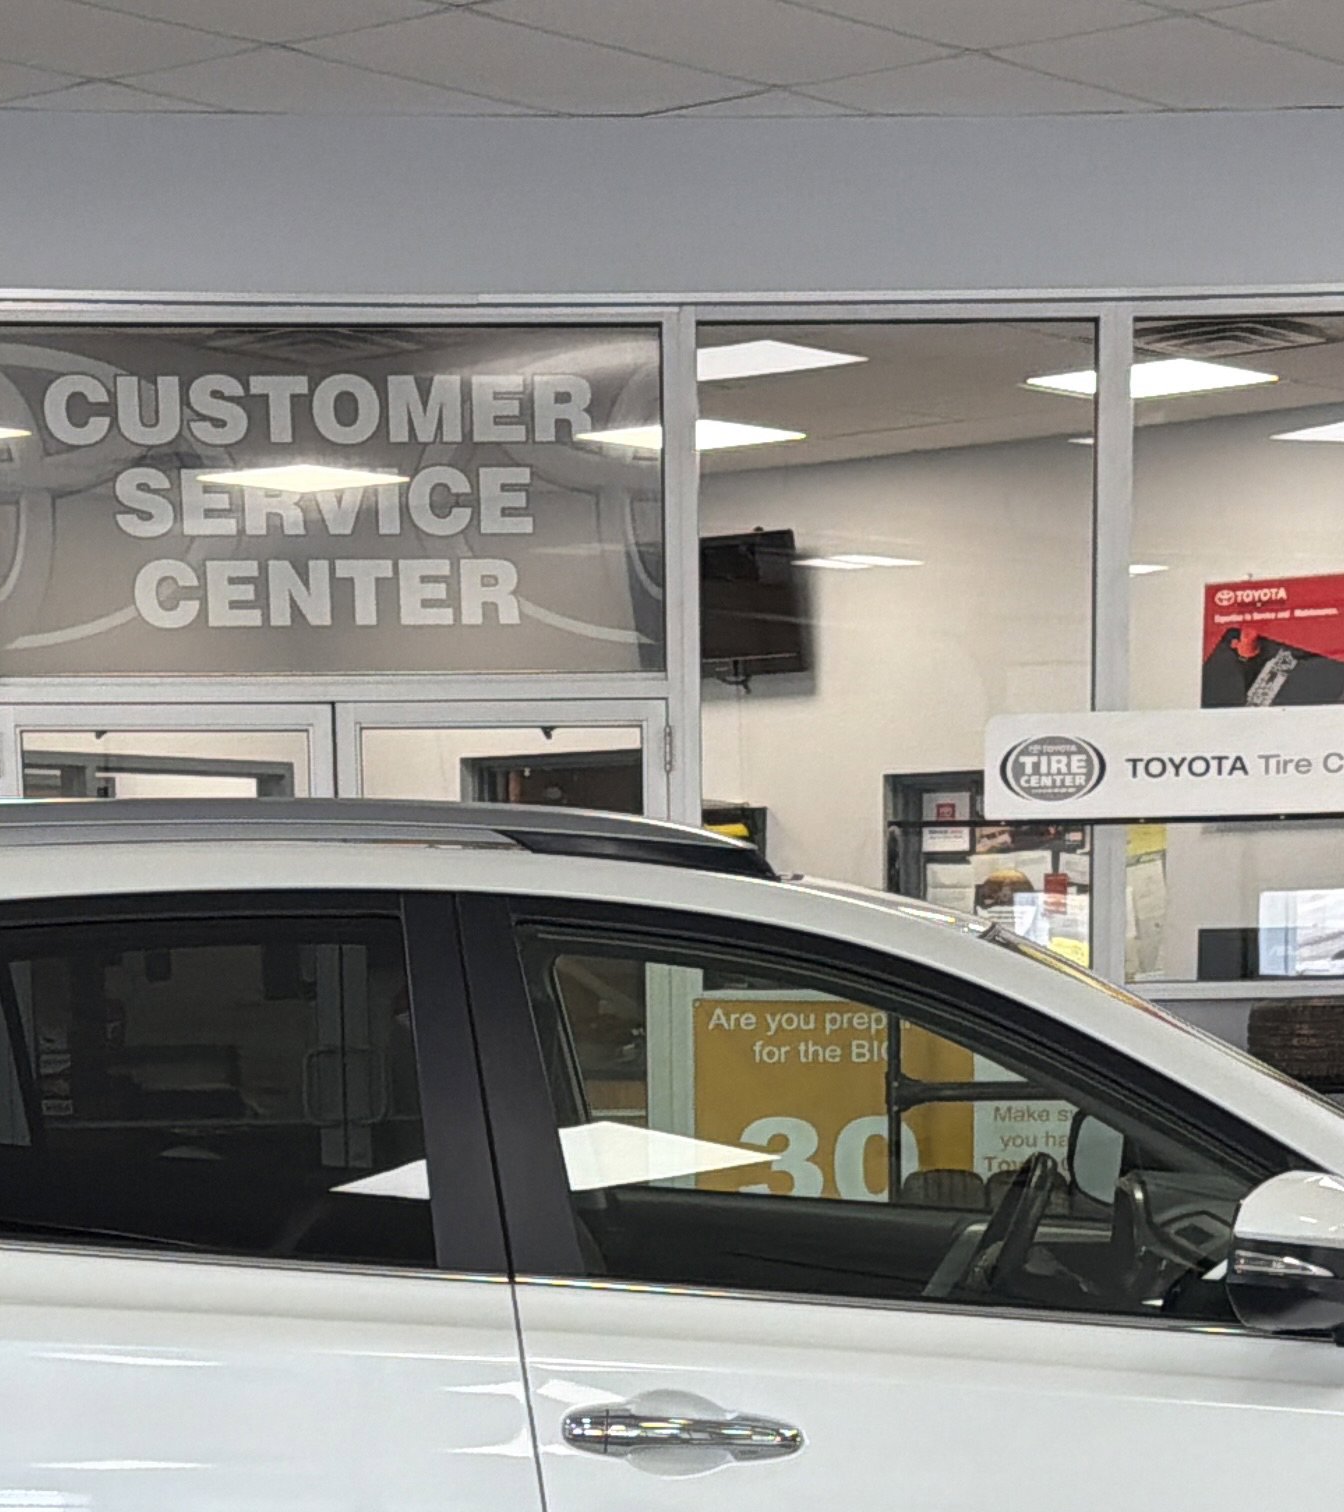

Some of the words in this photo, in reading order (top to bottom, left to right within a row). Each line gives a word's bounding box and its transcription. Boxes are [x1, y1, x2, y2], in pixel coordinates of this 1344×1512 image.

[43, 374, 593, 445] CUSTOMER
[113, 465, 534, 538] SERVICE
[133, 558, 521, 628] CENTER
[1236, 587, 1288, 603] TOYOTA
[1019, 754, 1088, 775] TIRE
[1125, 756, 1249, 778] TOYOTA
[1258, 754, 1313, 776] Tire
[1020, 775, 1086, 787] CENTER
[708, 1008, 757, 1030] Are
[766, 1011, 815, 1035] you
[825, 1011, 888, 1034] prep
[753, 1041, 791, 1063] for
[798, 1041, 842, 1063] the
[994, 1106, 1050, 1122] Make
[1000, 1134, 1037, 1151] you
[1045, 1131, 1069, 1147] ha
